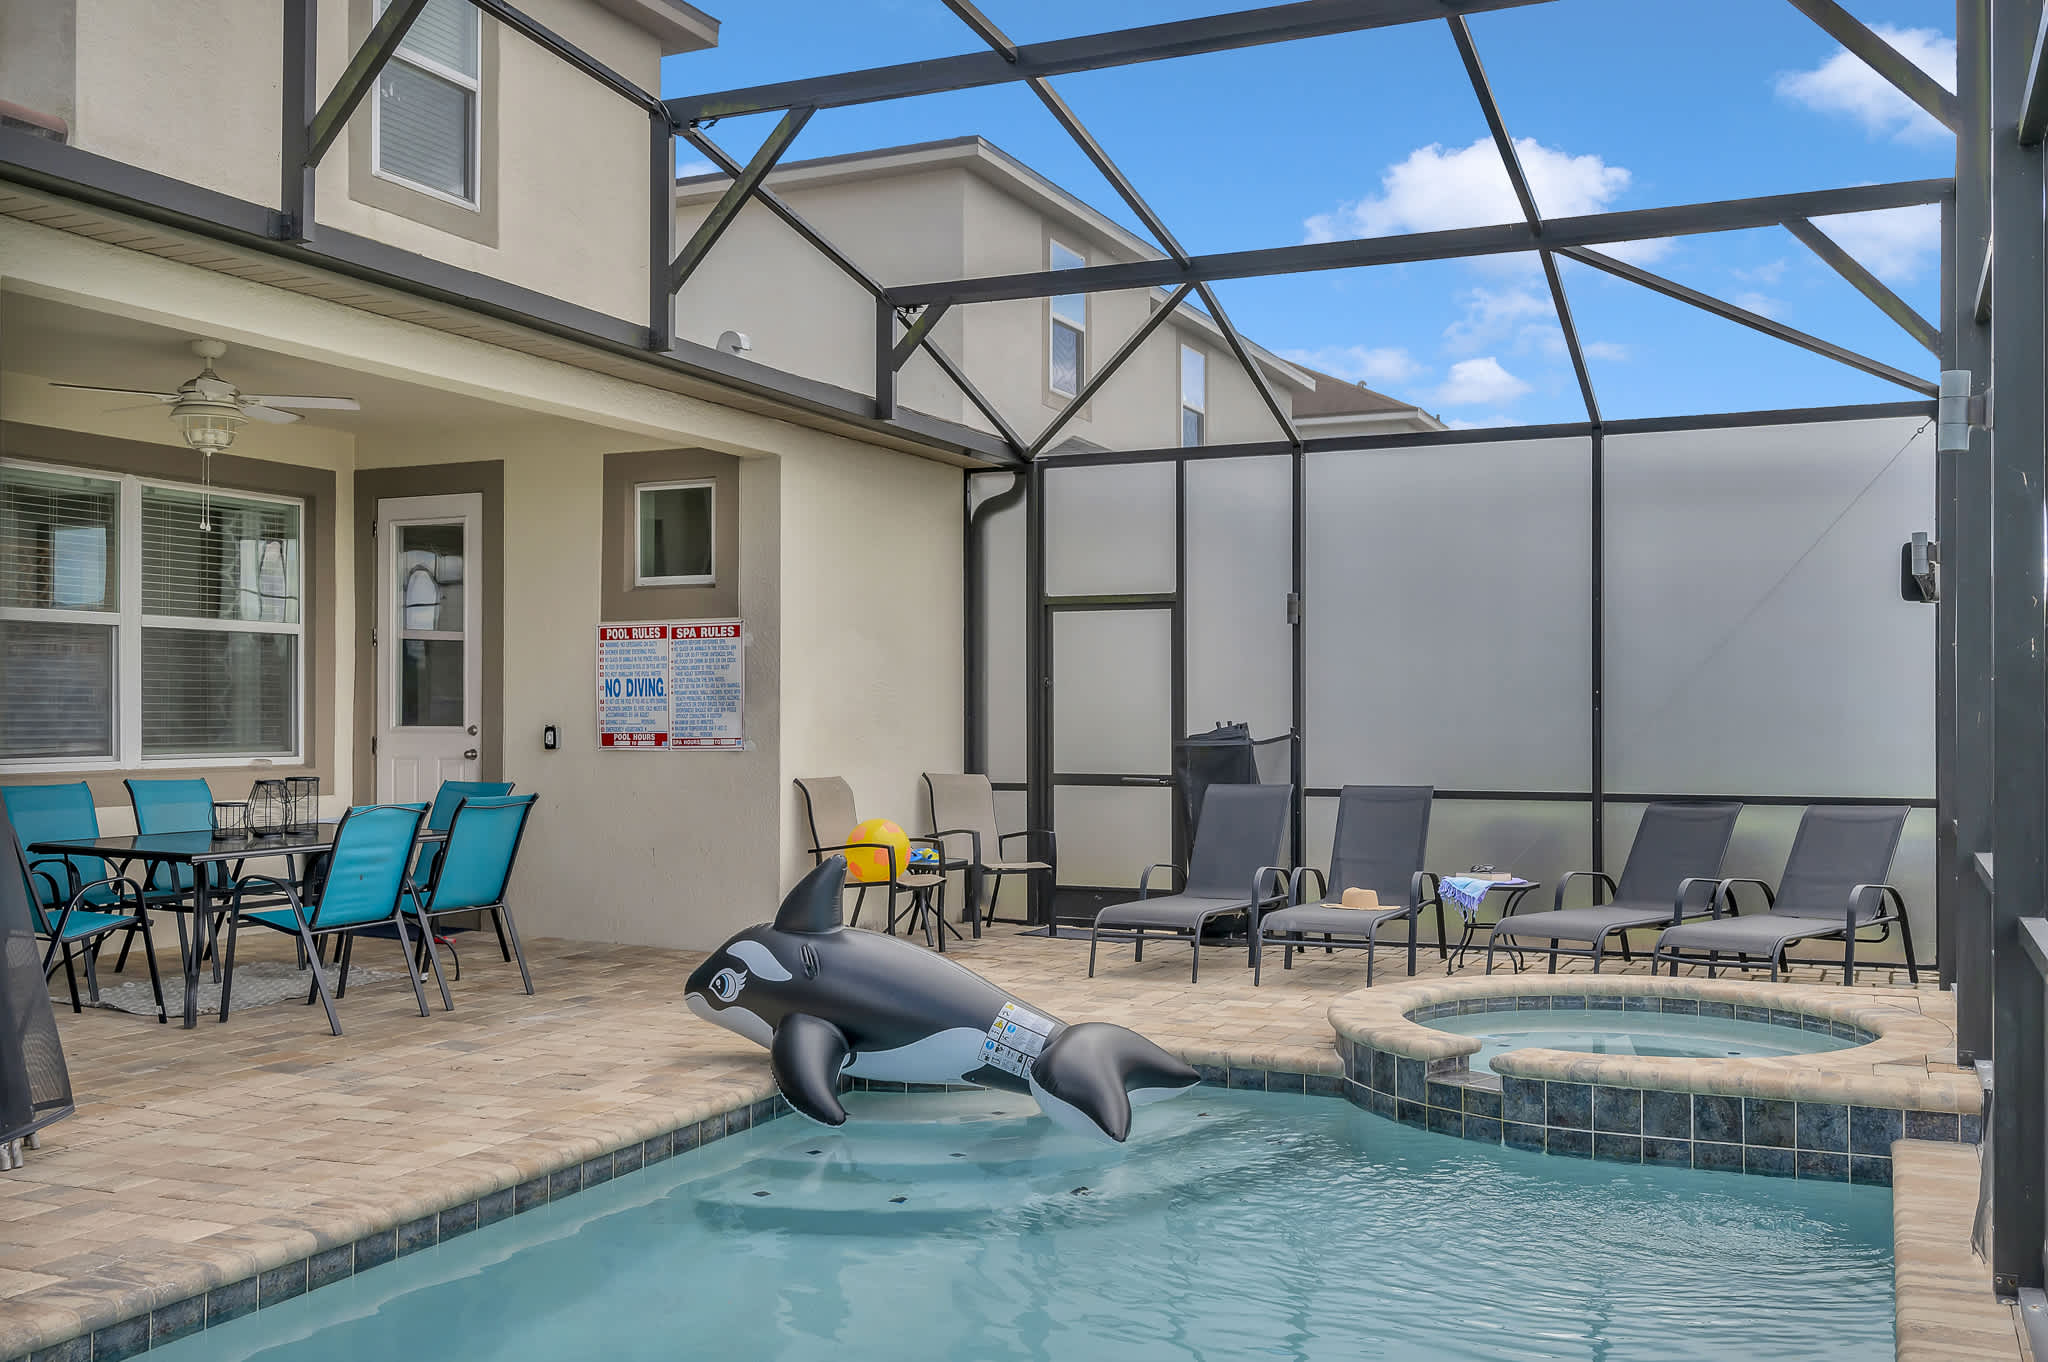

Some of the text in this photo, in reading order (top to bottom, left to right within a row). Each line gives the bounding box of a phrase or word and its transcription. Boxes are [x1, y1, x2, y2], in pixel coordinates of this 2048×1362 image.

[606, 627, 661, 640] POOL RULES
[676, 626, 735, 639] SPA RULES
[605, 677, 667, 698] NO DIVING.
[613, 733, 656, 741] POOL HOURS
